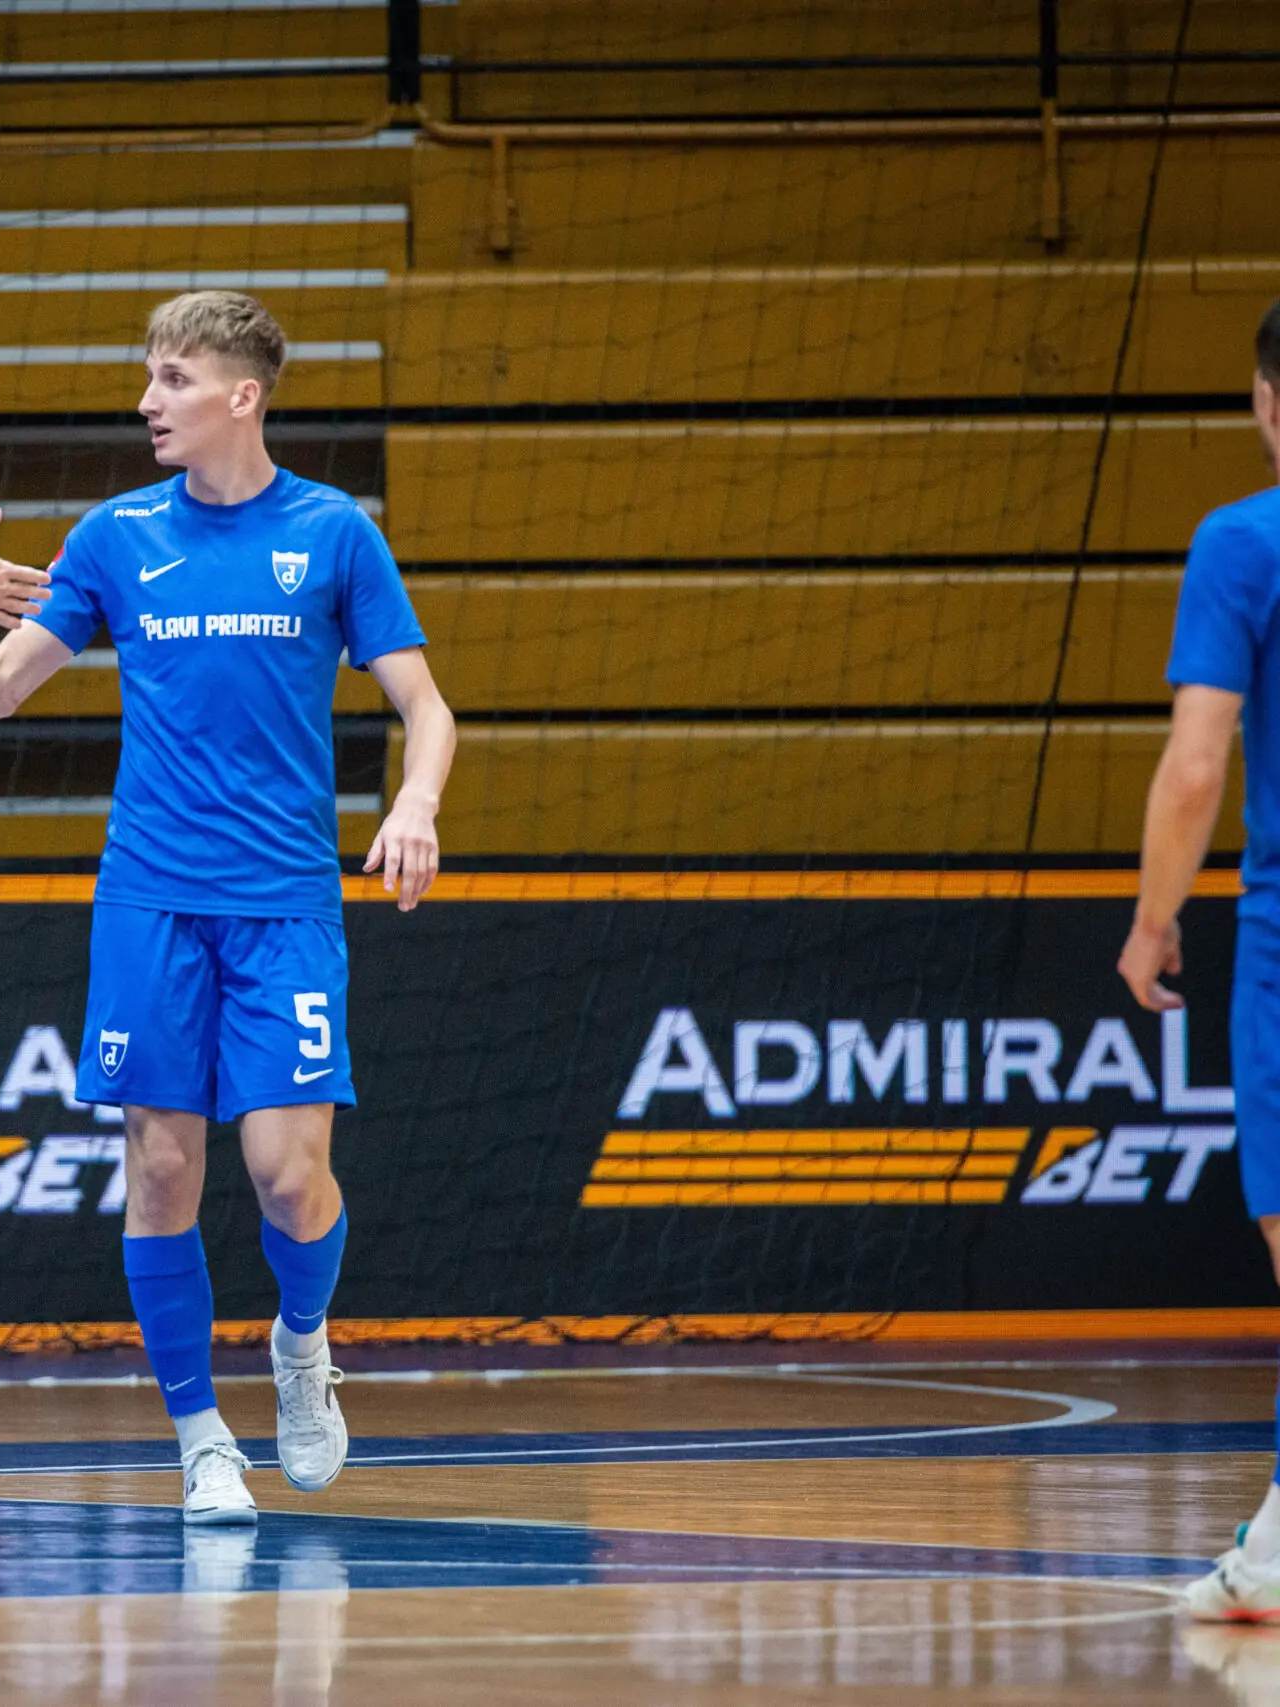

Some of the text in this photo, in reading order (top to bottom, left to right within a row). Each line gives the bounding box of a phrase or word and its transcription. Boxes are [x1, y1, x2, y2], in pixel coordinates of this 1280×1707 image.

[144, 615, 199, 642] PLAVI
[292, 992, 332, 1060] 5
[616, 1007, 1236, 1118] ADMIRAL
[1019, 1125, 1237, 1204] BET
